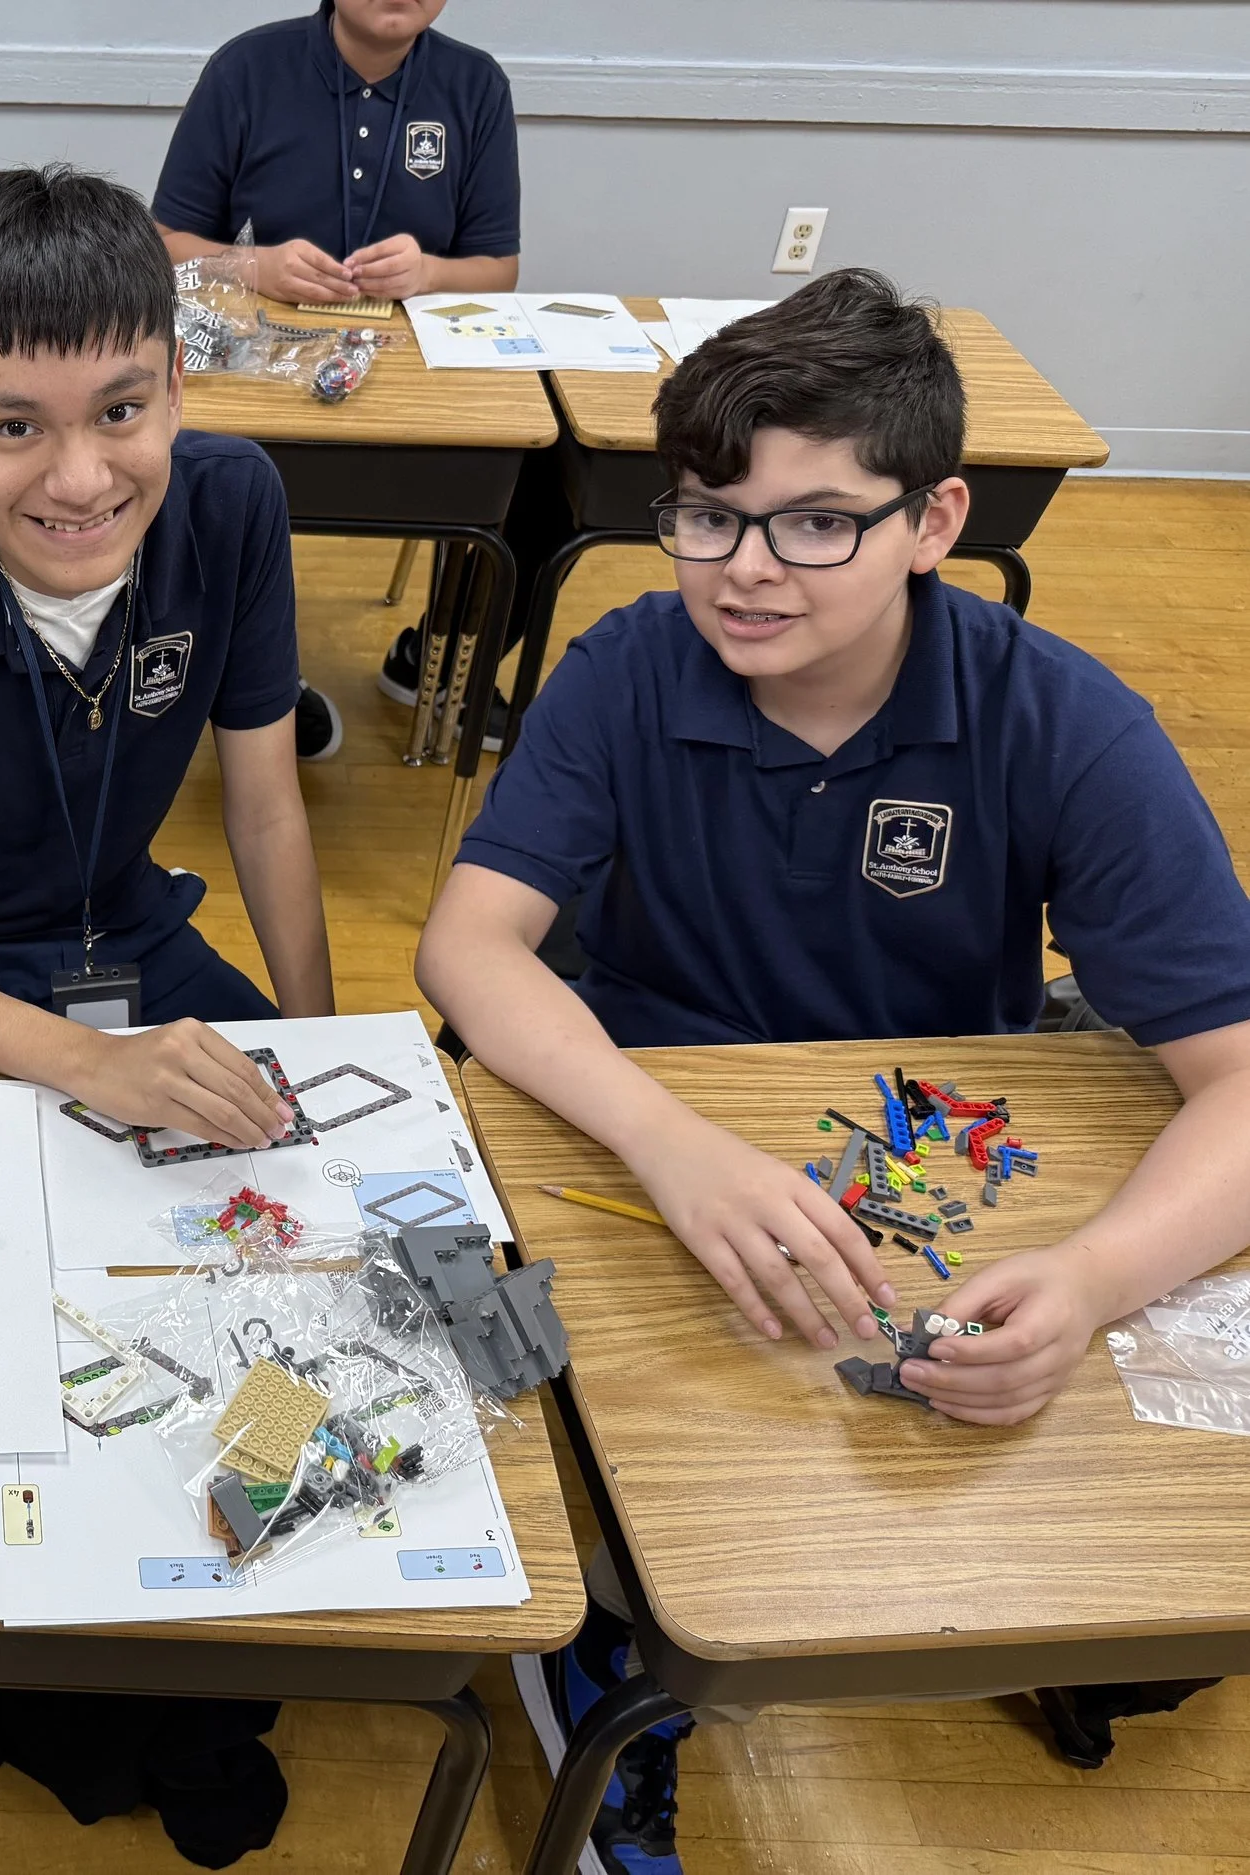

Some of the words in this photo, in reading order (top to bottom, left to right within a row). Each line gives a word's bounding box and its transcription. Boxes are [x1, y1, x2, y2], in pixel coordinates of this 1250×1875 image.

[187, 331, 213, 354] 17
[868, 861, 879, 869] St.
[879, 863, 911, 874] Anthony
[911, 866, 938, 877] School
[485, 1529, 496, 1541] 3
